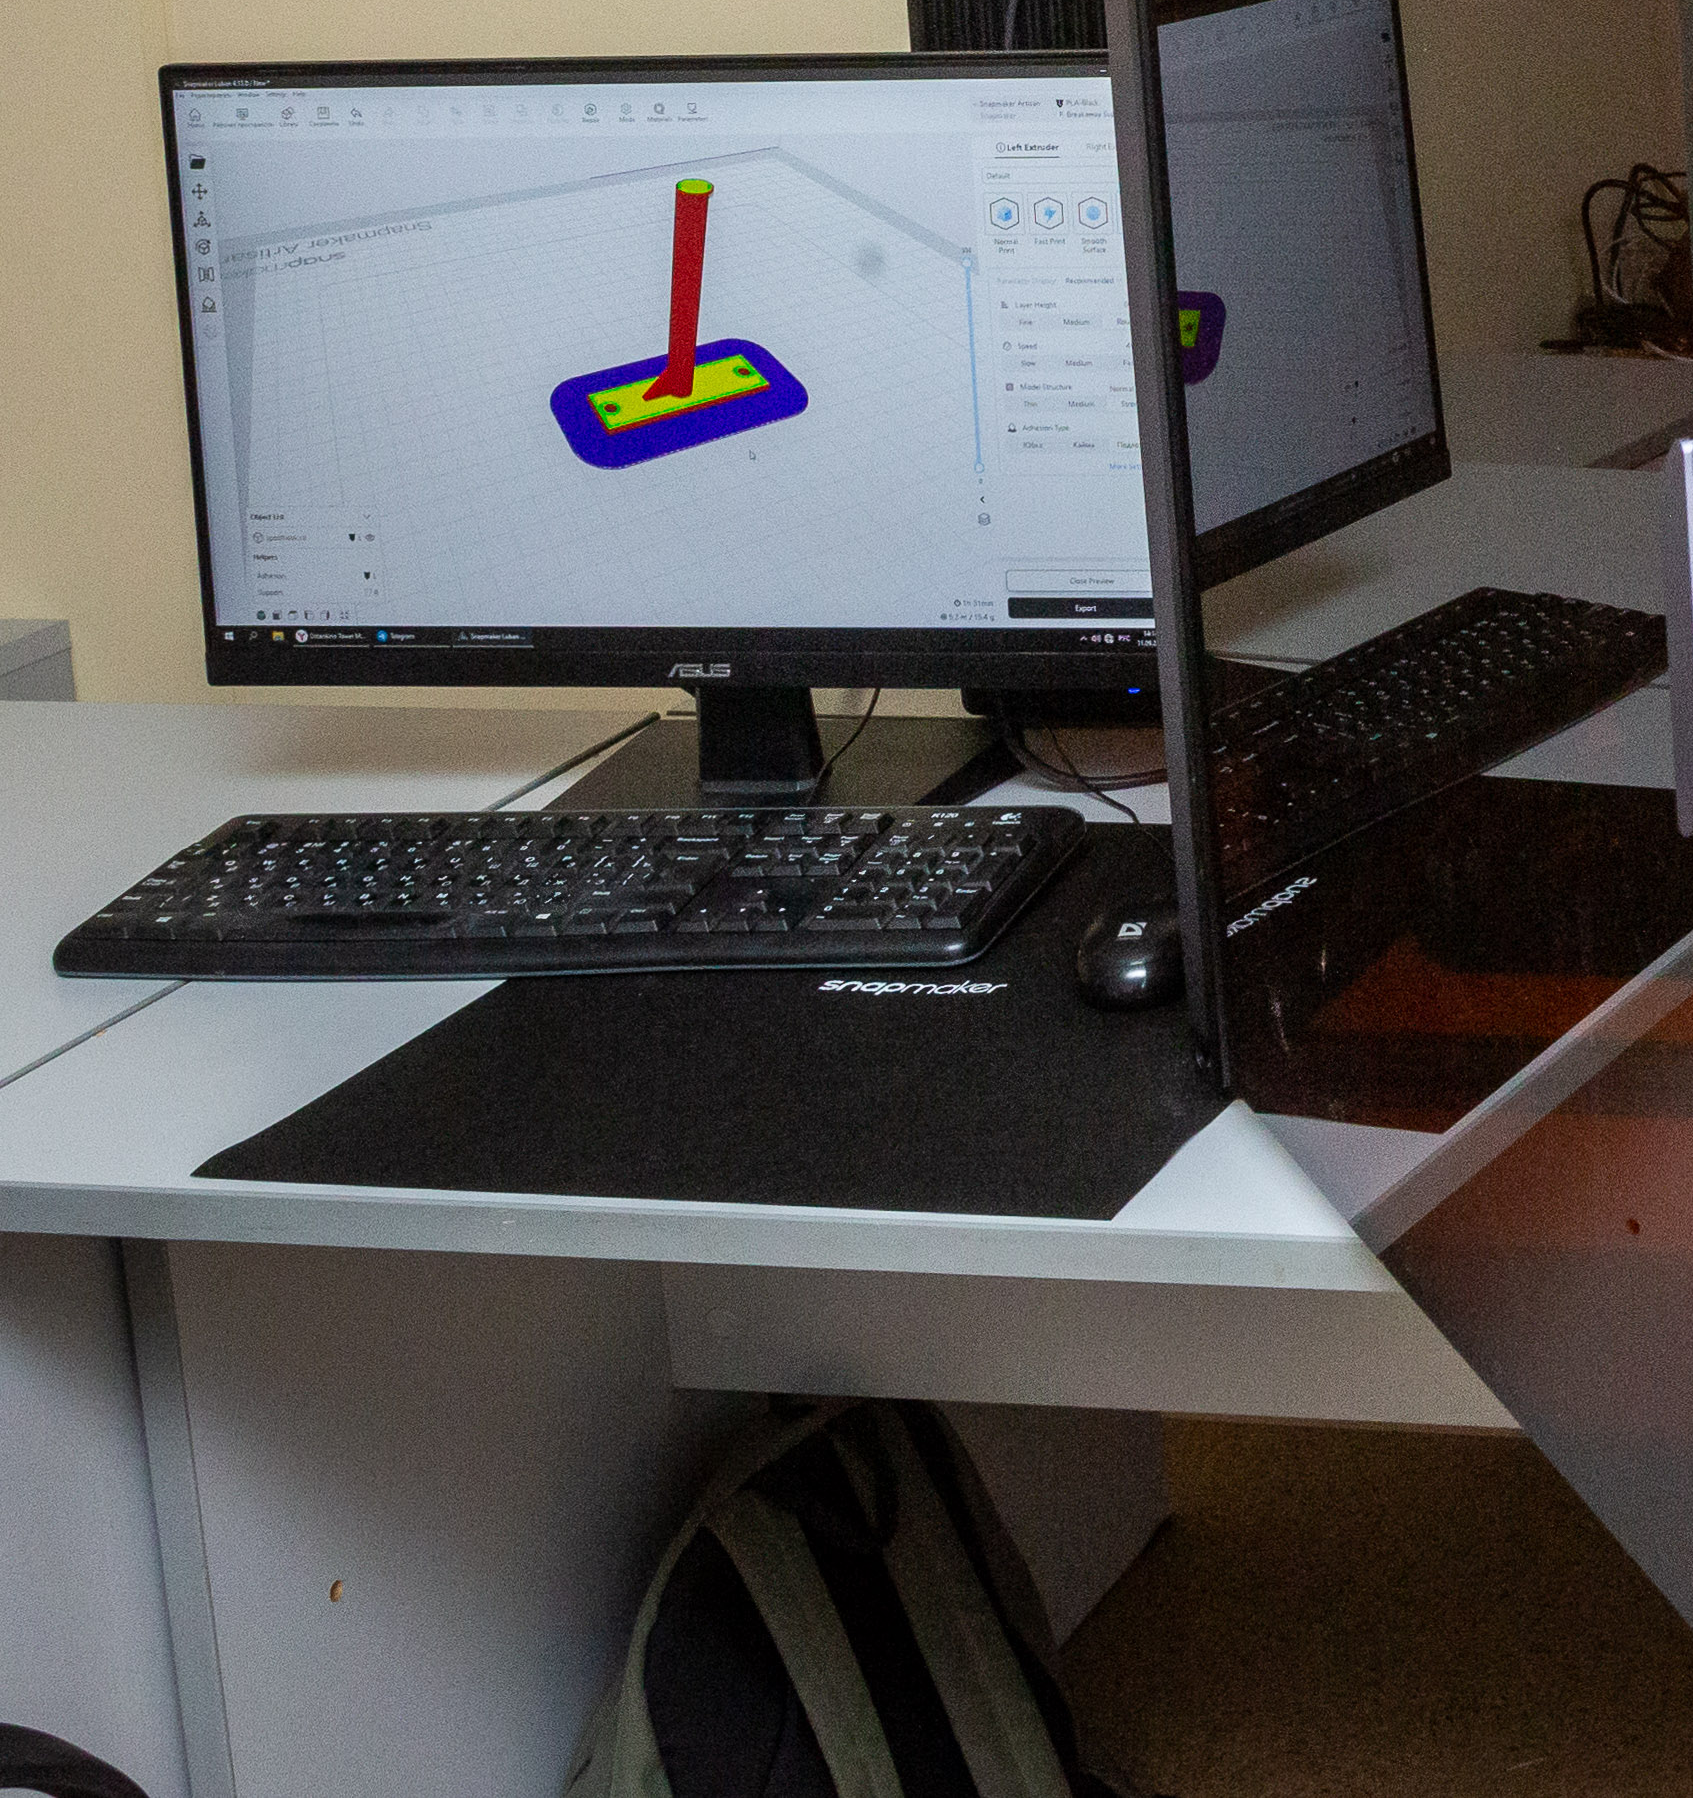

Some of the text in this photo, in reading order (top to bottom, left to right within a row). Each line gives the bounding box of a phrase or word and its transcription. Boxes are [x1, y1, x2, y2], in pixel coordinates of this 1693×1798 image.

[1006, 143, 1059, 151] Left Extruder
[1075, 604, 1097, 613] Export
[668, 663, 731, 678] ASUS
[818, 977, 1008, 997] snapmaker
